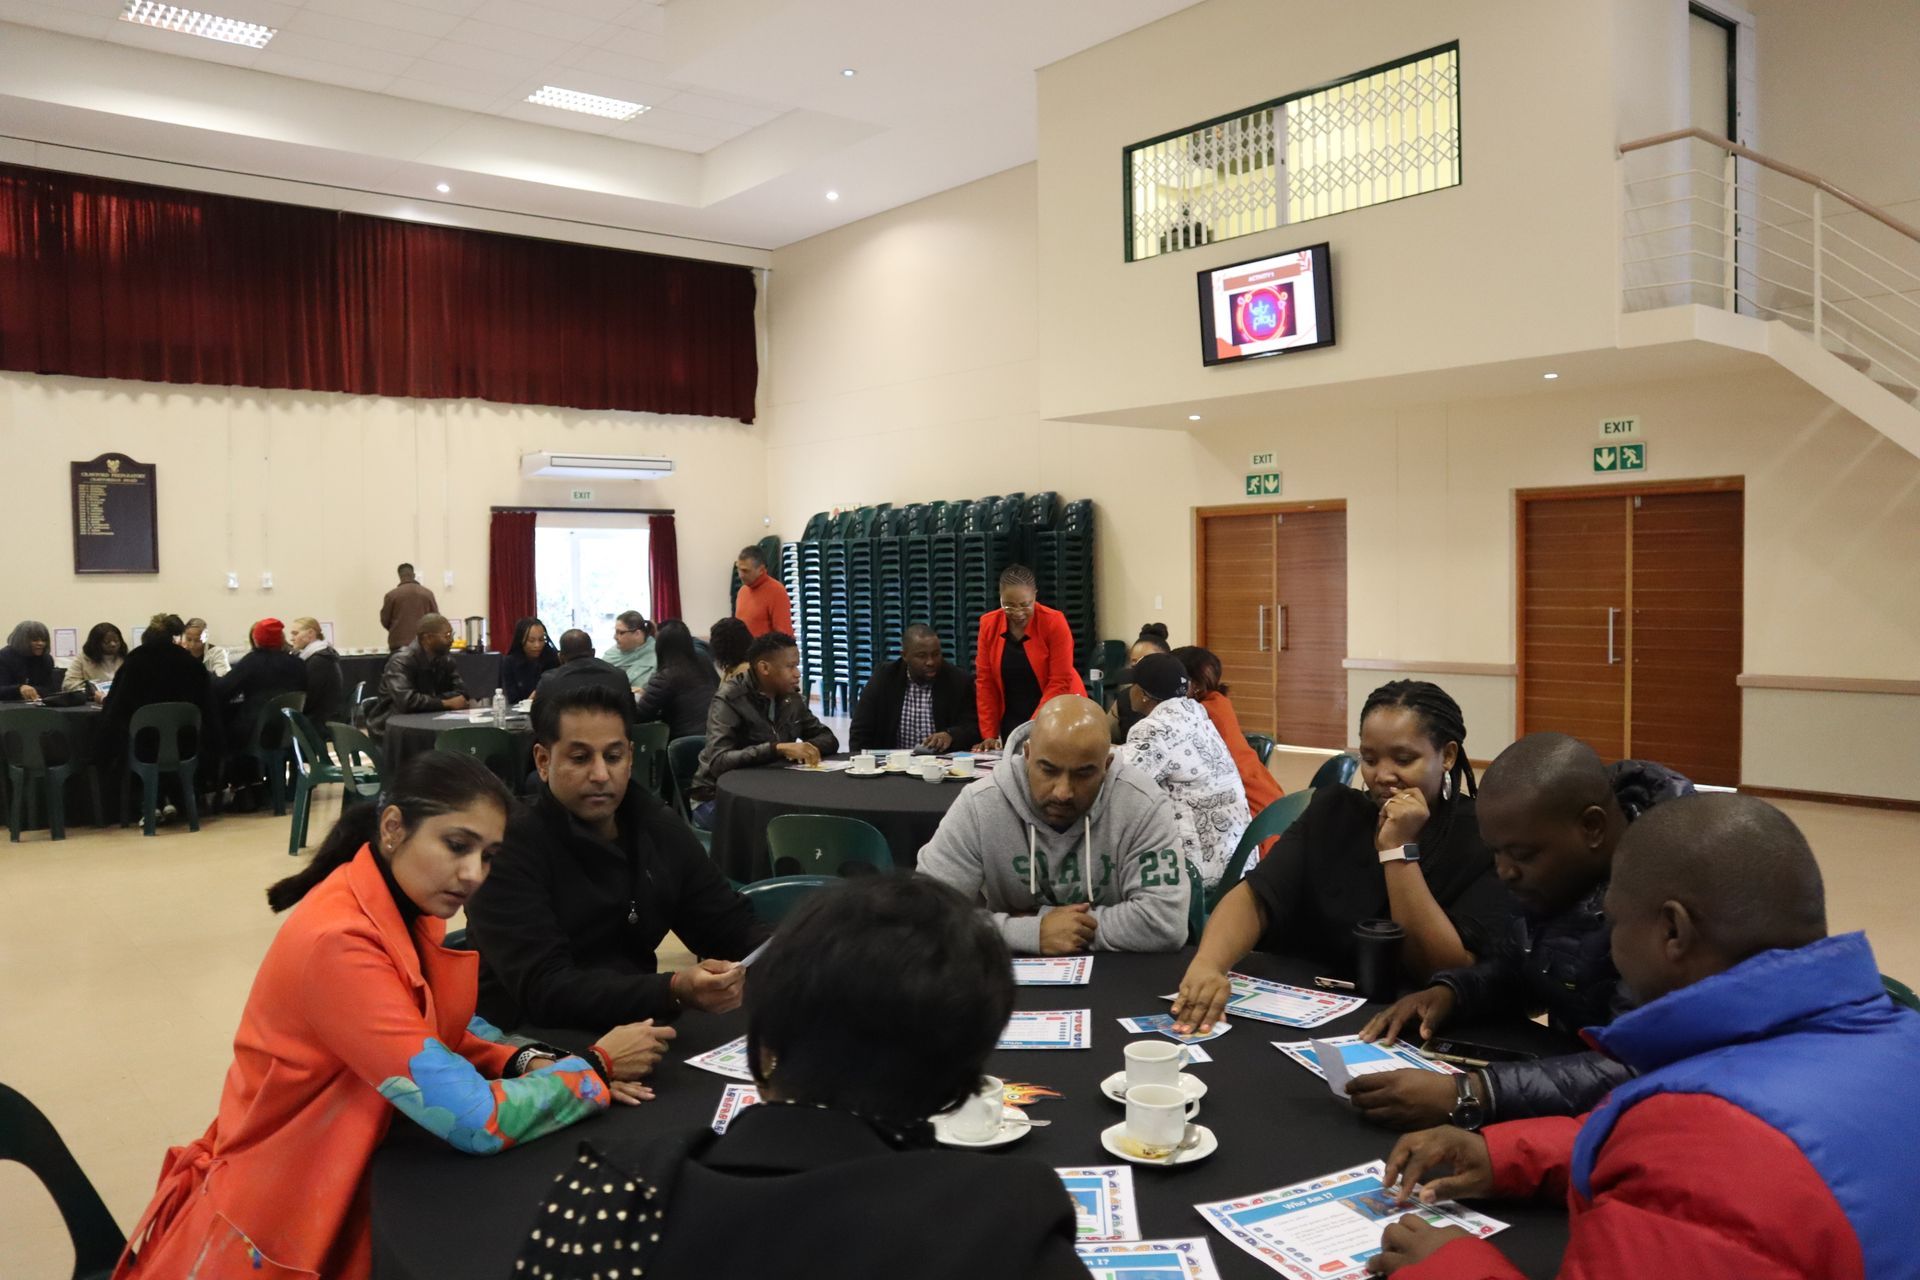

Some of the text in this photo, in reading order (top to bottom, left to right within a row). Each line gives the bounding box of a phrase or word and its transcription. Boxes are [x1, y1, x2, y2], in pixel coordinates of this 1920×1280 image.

[1604, 420, 1634, 434] EXIT
[1253, 454, 1273, 464] EXIT
[573, 491, 591, 499] EXIT
[1139, 848, 1180, 888] 23
[1282, 1199, 1306, 1210] Who
